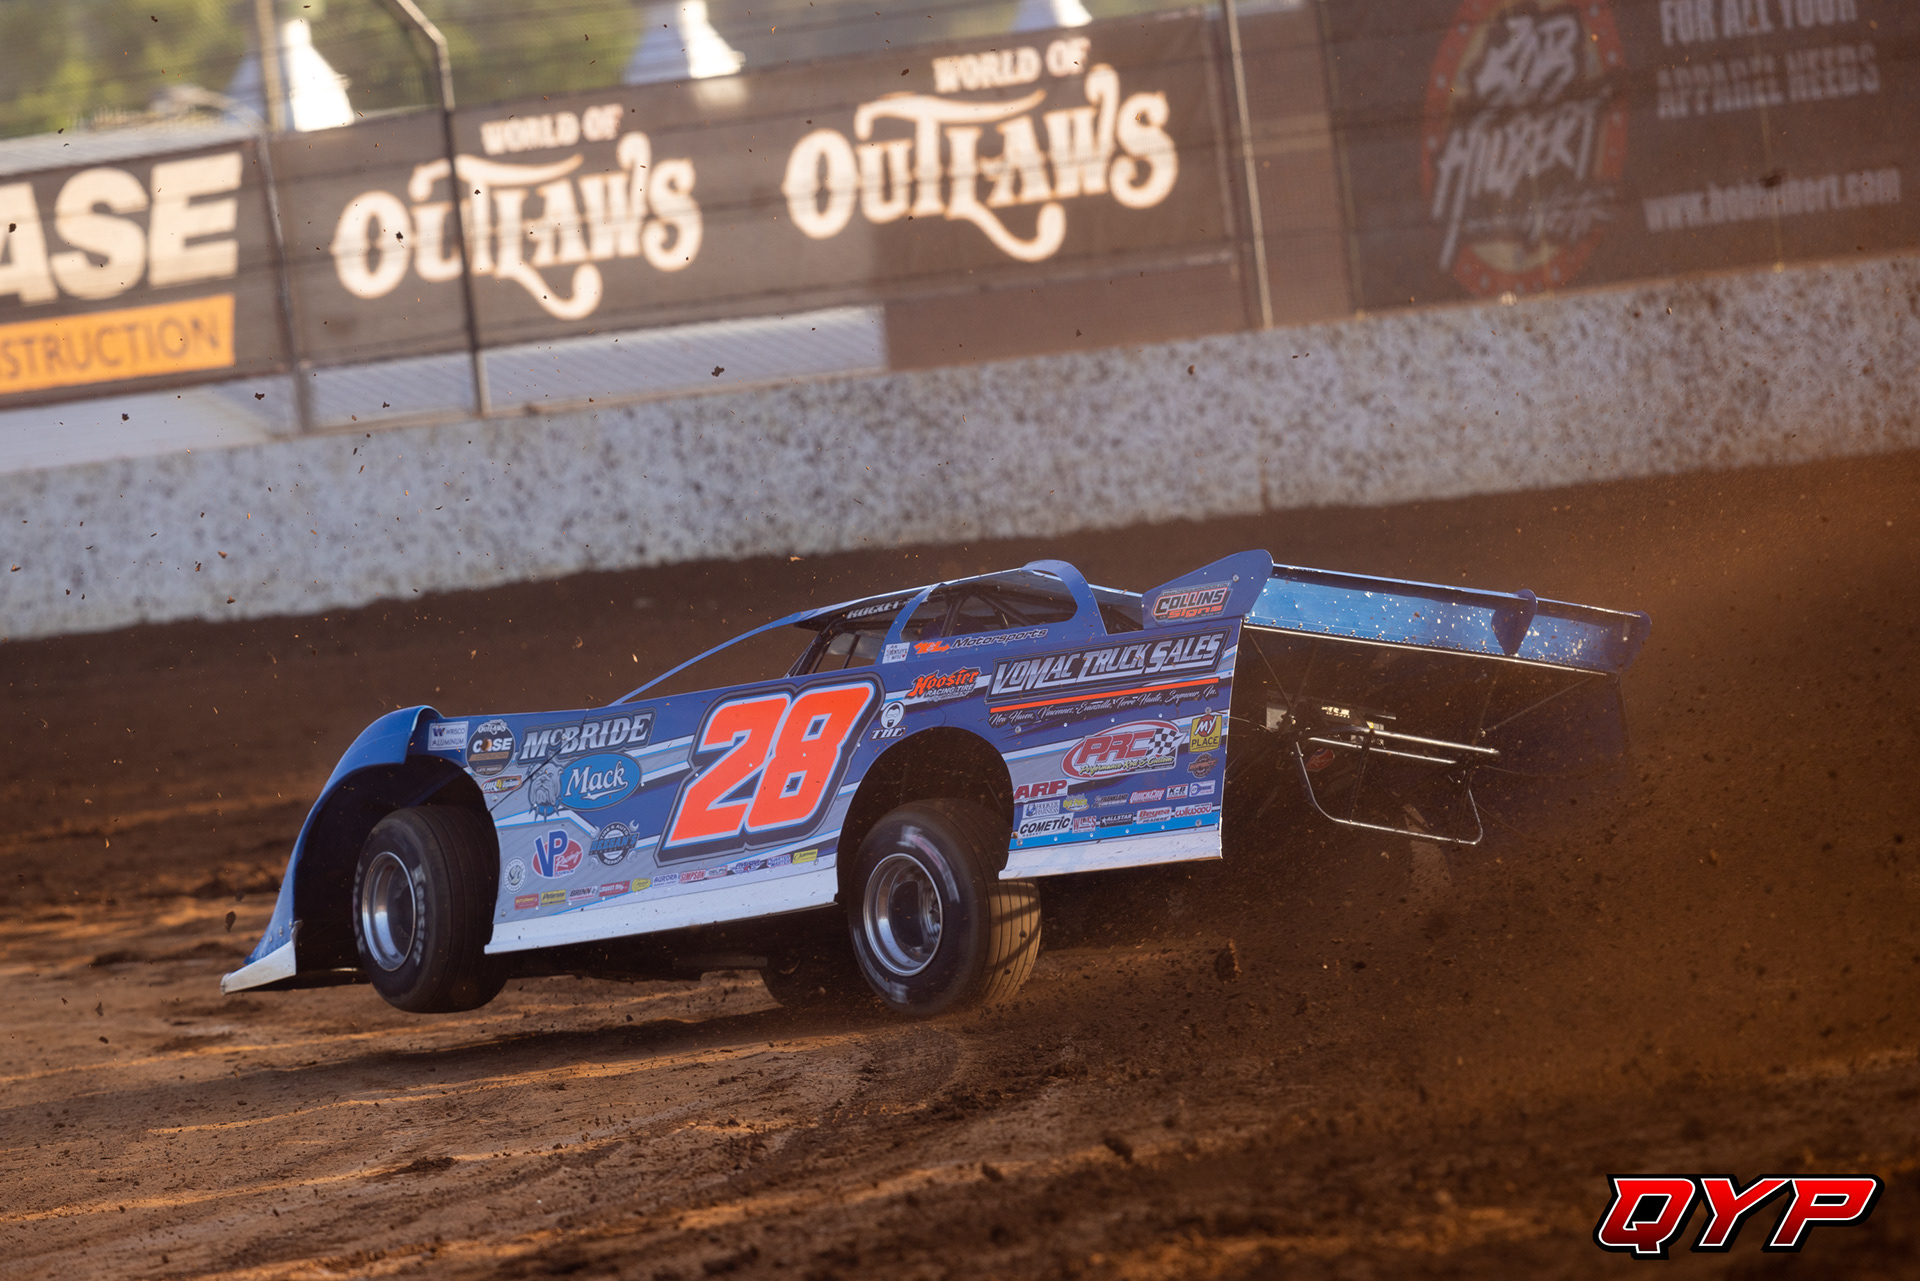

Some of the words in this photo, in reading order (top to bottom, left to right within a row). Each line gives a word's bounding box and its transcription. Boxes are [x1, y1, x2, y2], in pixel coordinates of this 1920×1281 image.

[932, 47, 1041, 93] WORLD
[1046, 37, 1091, 76] OF
[482, 112, 579, 154] WORLD
[583, 104, 625, 142] OF
[1154, 590, 1225, 614] COLLINS
[951, 629, 1048, 648] Motorsports
[1076, 643, 1151, 683] TRUCK
[1145, 633, 1224, 673] SALES
[906, 668, 980, 697] Hoosier
[926, 686, 956, 696] RACING
[957, 683, 975, 692] TIRE
[473, 738, 513, 753] CSE
[1075, 730, 1156, 765] PRC
[1192, 737, 1218, 747] PLACE
[669, 686, 871, 841] 28
[565, 761, 629, 800] Mack
[1014, 780, 1067, 800] ARP
[1020, 816, 1070, 834] COMETIC
[535, 830, 568, 877] VP
[654, 875, 677, 883] AURORA
[680, 870, 706, 882] SIMPSON
